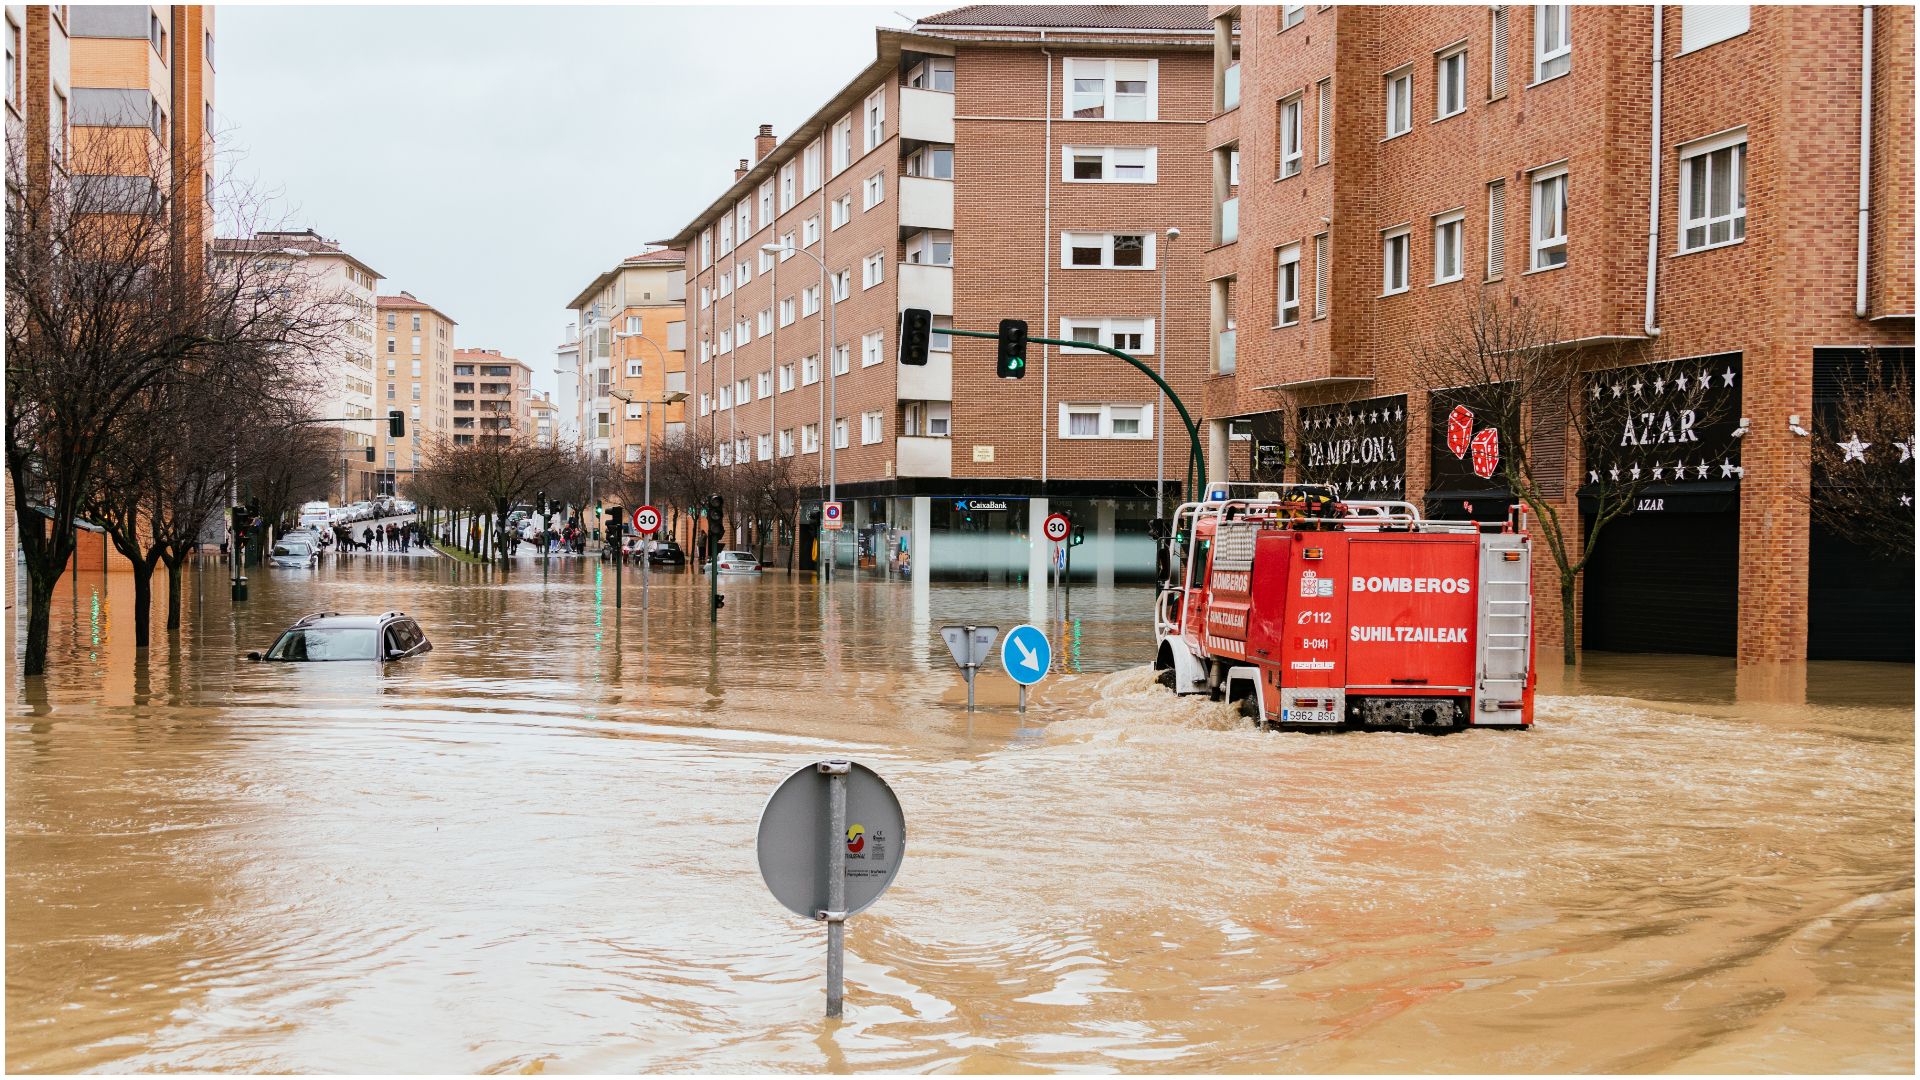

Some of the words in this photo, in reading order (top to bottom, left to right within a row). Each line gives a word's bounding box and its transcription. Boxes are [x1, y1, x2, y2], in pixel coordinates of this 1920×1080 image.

[1621, 409, 1699, 446] AZAR
[1308, 436, 1396, 467] PAMPLONA
[969, 501, 1007, 509] CaixaBank
[1637, 499, 1664, 511] AZAR
[639, 515, 656, 525] 30
[1049, 523, 1065, 532] 30
[1213, 572, 1248, 592] BOMBEROS
[1352, 577, 1470, 594] BOMBEROS
[1210, 611, 1244, 628] SUHILTZAILEAK
[1313, 612, 1331, 624] 112
[1350, 626, 1468, 643] SUHILTZAILEAK
[1303, 638, 1328, 649] B-0141
[1291, 658, 1335, 670] rosenbauer
[1290, 711, 1313, 721] 5962
[1318, 711, 1336, 721] BSG
